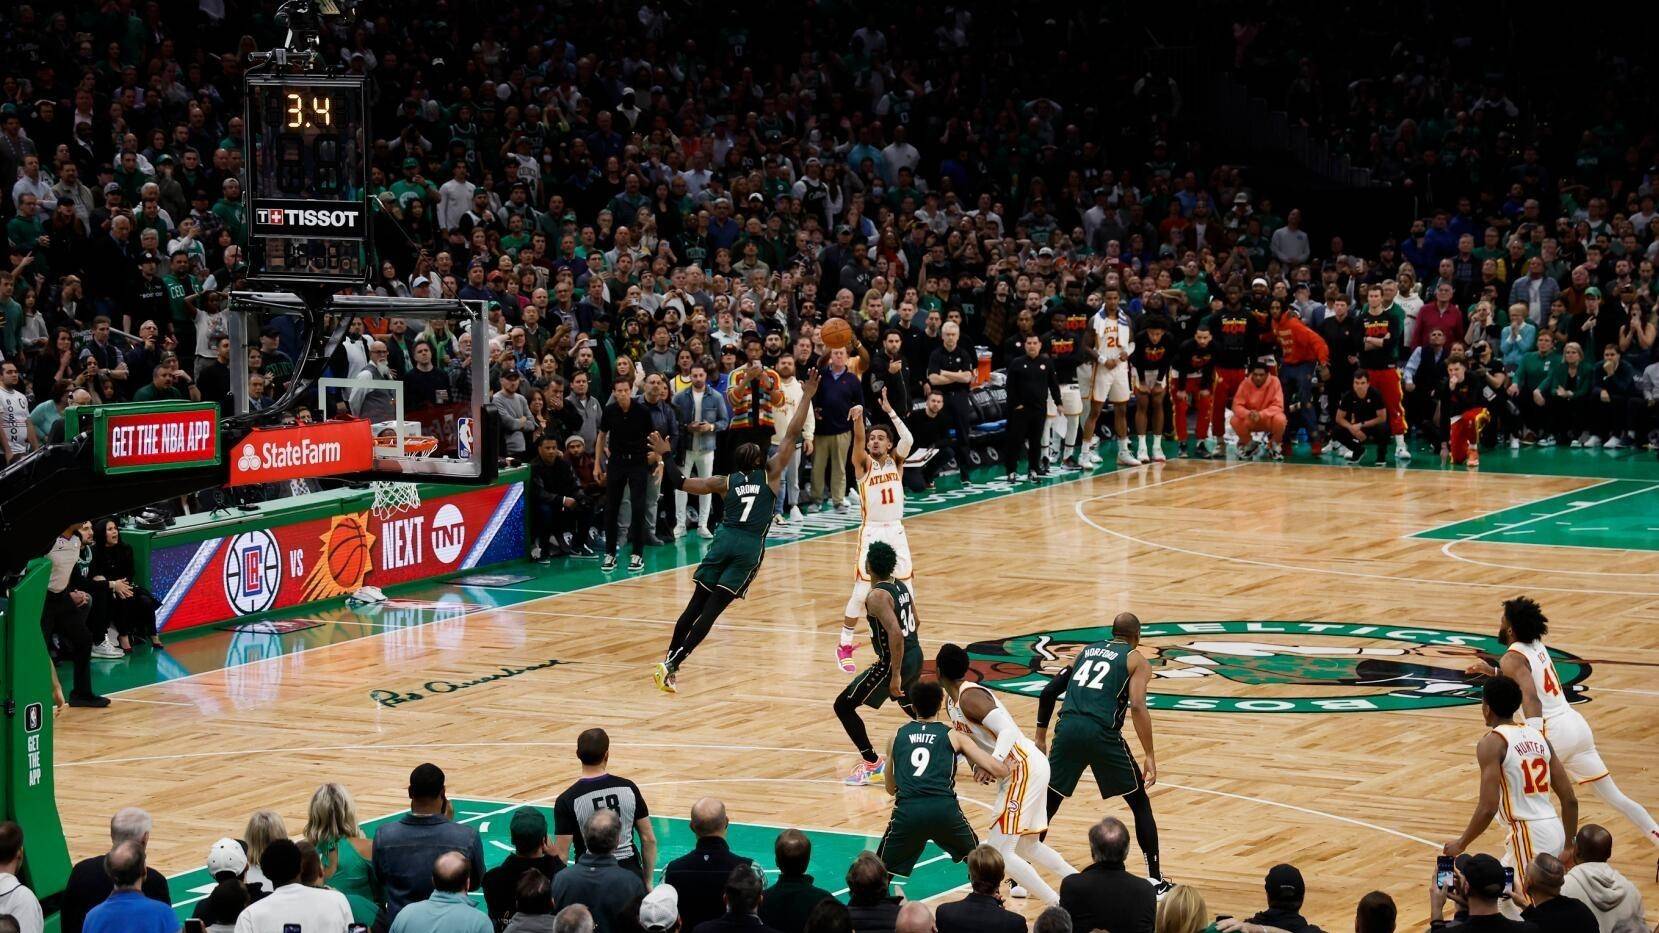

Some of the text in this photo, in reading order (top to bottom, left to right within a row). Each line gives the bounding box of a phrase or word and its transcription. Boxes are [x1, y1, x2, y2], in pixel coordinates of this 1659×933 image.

[287, 93, 331, 128] 3.4
[284, 209, 359, 228] TISSOT
[112, 420, 210, 458] GET THE NBA APP
[869, 471, 899, 487] ATLANTA
[735, 484, 761, 497] BROWN
[881, 487, 895, 505] 11
[740, 495, 756, 522] 7
[382, 515, 425, 571] NEXT
[289, 548, 303, 578] VS
[900, 604, 916, 637] 36
[1084, 647, 1119, 661] HORFORD
[1073, 659, 1111, 690] 42
[28, 734, 40, 753] GET
[908, 733, 937, 745] WHITE
[1514, 741, 1546, 756] HUNTER
[28, 751, 41, 770] THE
[910, 747, 931, 777] 9
[29, 768, 42, 787] APP
[1521, 757, 1549, 795] 12
